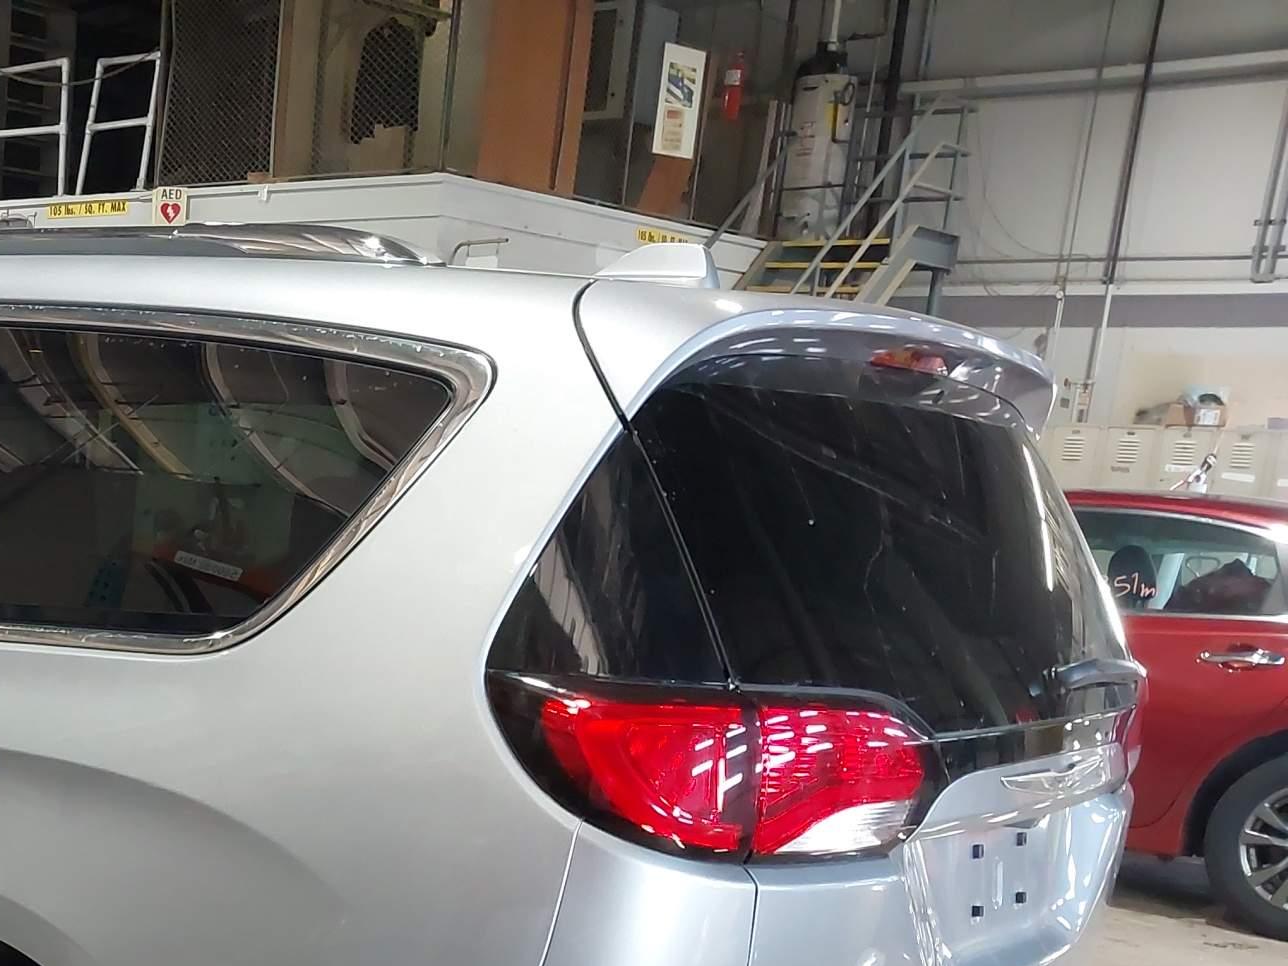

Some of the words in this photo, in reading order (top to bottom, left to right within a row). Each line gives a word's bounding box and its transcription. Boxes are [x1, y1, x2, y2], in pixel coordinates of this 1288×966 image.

[162, 188, 182, 200] AED
[49, 205, 62, 216] 105
[64, 204, 76, 215] lbs.
[84, 204, 95, 215] SQ.
[98, 203, 108, 213] FT.
[112, 202, 126, 212] MAX
